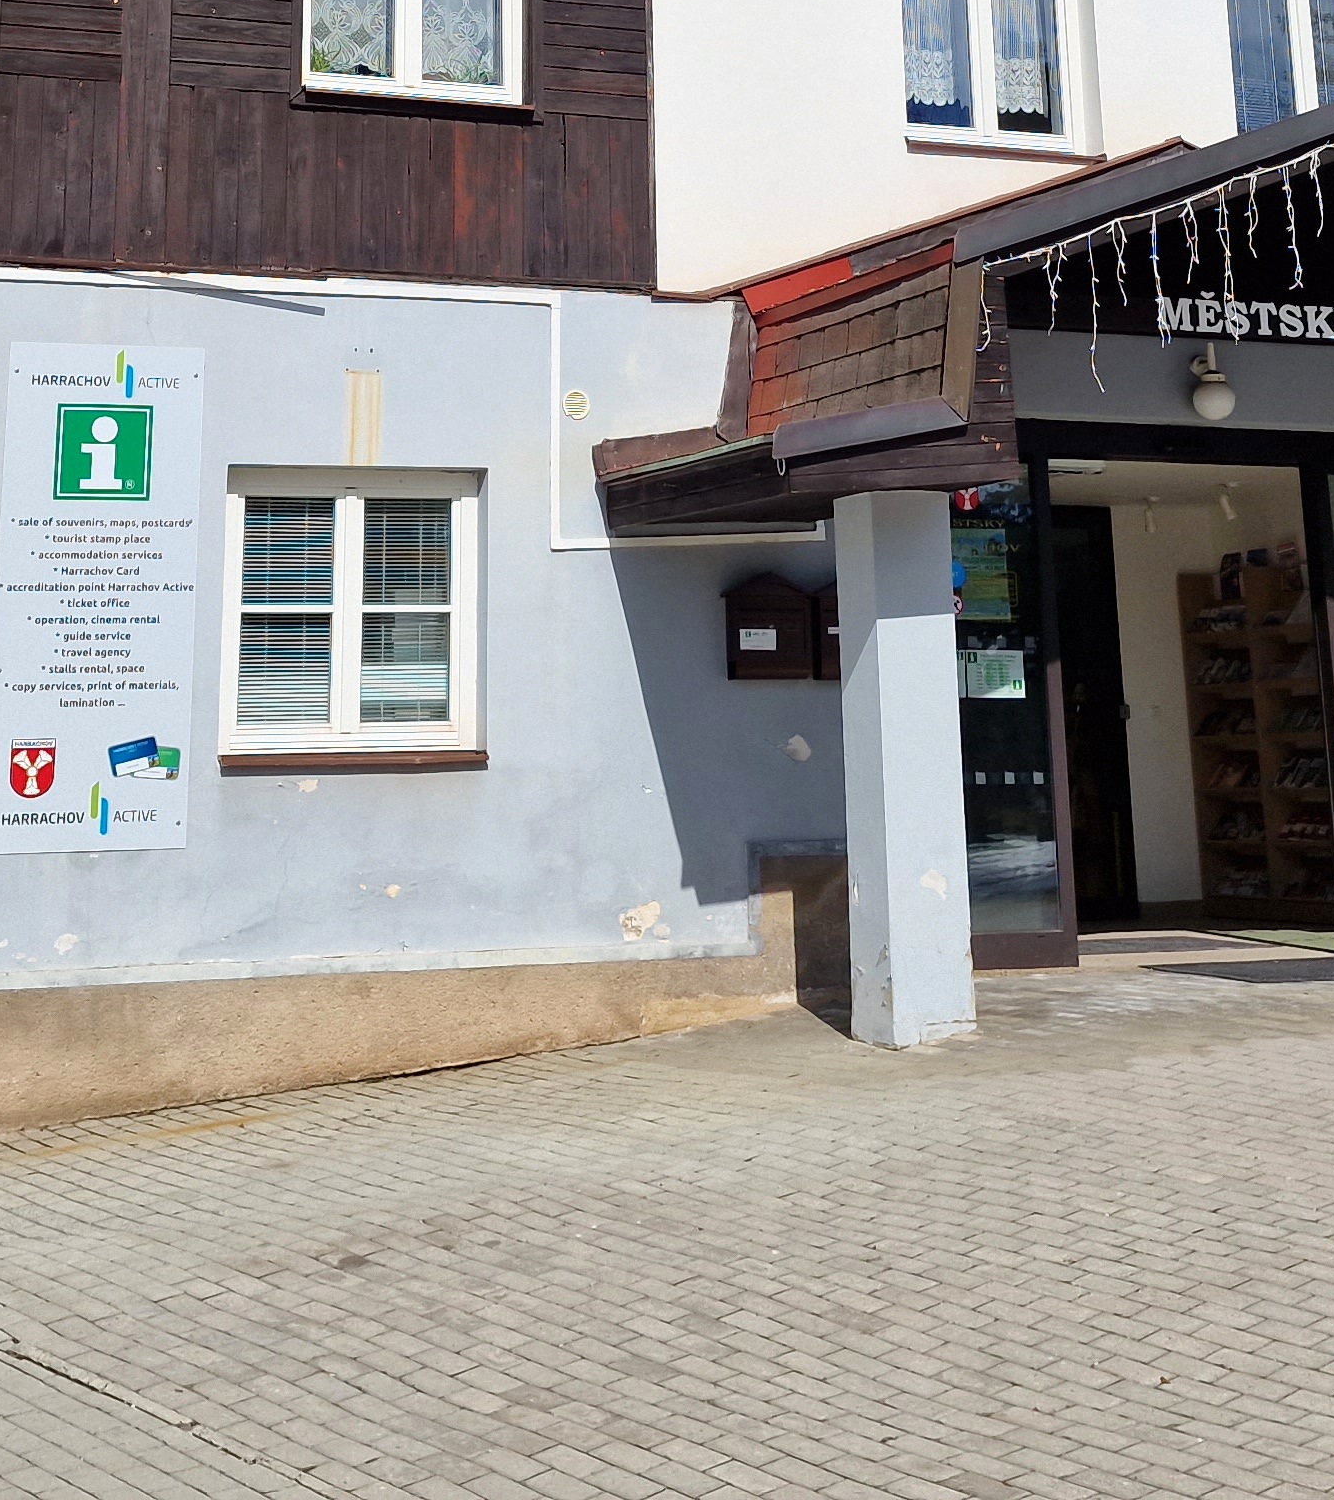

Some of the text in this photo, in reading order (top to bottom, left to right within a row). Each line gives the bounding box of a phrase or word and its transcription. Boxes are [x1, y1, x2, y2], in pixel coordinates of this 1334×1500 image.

[32, 375, 179, 389] HARRACHOV ACTIVE
[19, 517, 189, 529] sale of souvenirs, maps, postcards
[53, 534, 150, 545] tourist stamp place
[39, 550, 162, 559] accommodation services
[62, 566, 139, 575] Harrachov Card
[7, 582, 194, 593] accreditation point Harrachov Active
[68, 598, 129, 607] ticket office
[35, 615, 160, 626] operation, cinema rental
[64, 631, 131, 642] guide service
[62, 647, 130, 658] travel agency
[49, 664, 144, 674] stalls rental, space
[12, 680, 179, 693] copy services, print of materials,
[60, 698, 114, 707] lamination
[2, 810, 157, 825] HARRACHOV ACTIVE
